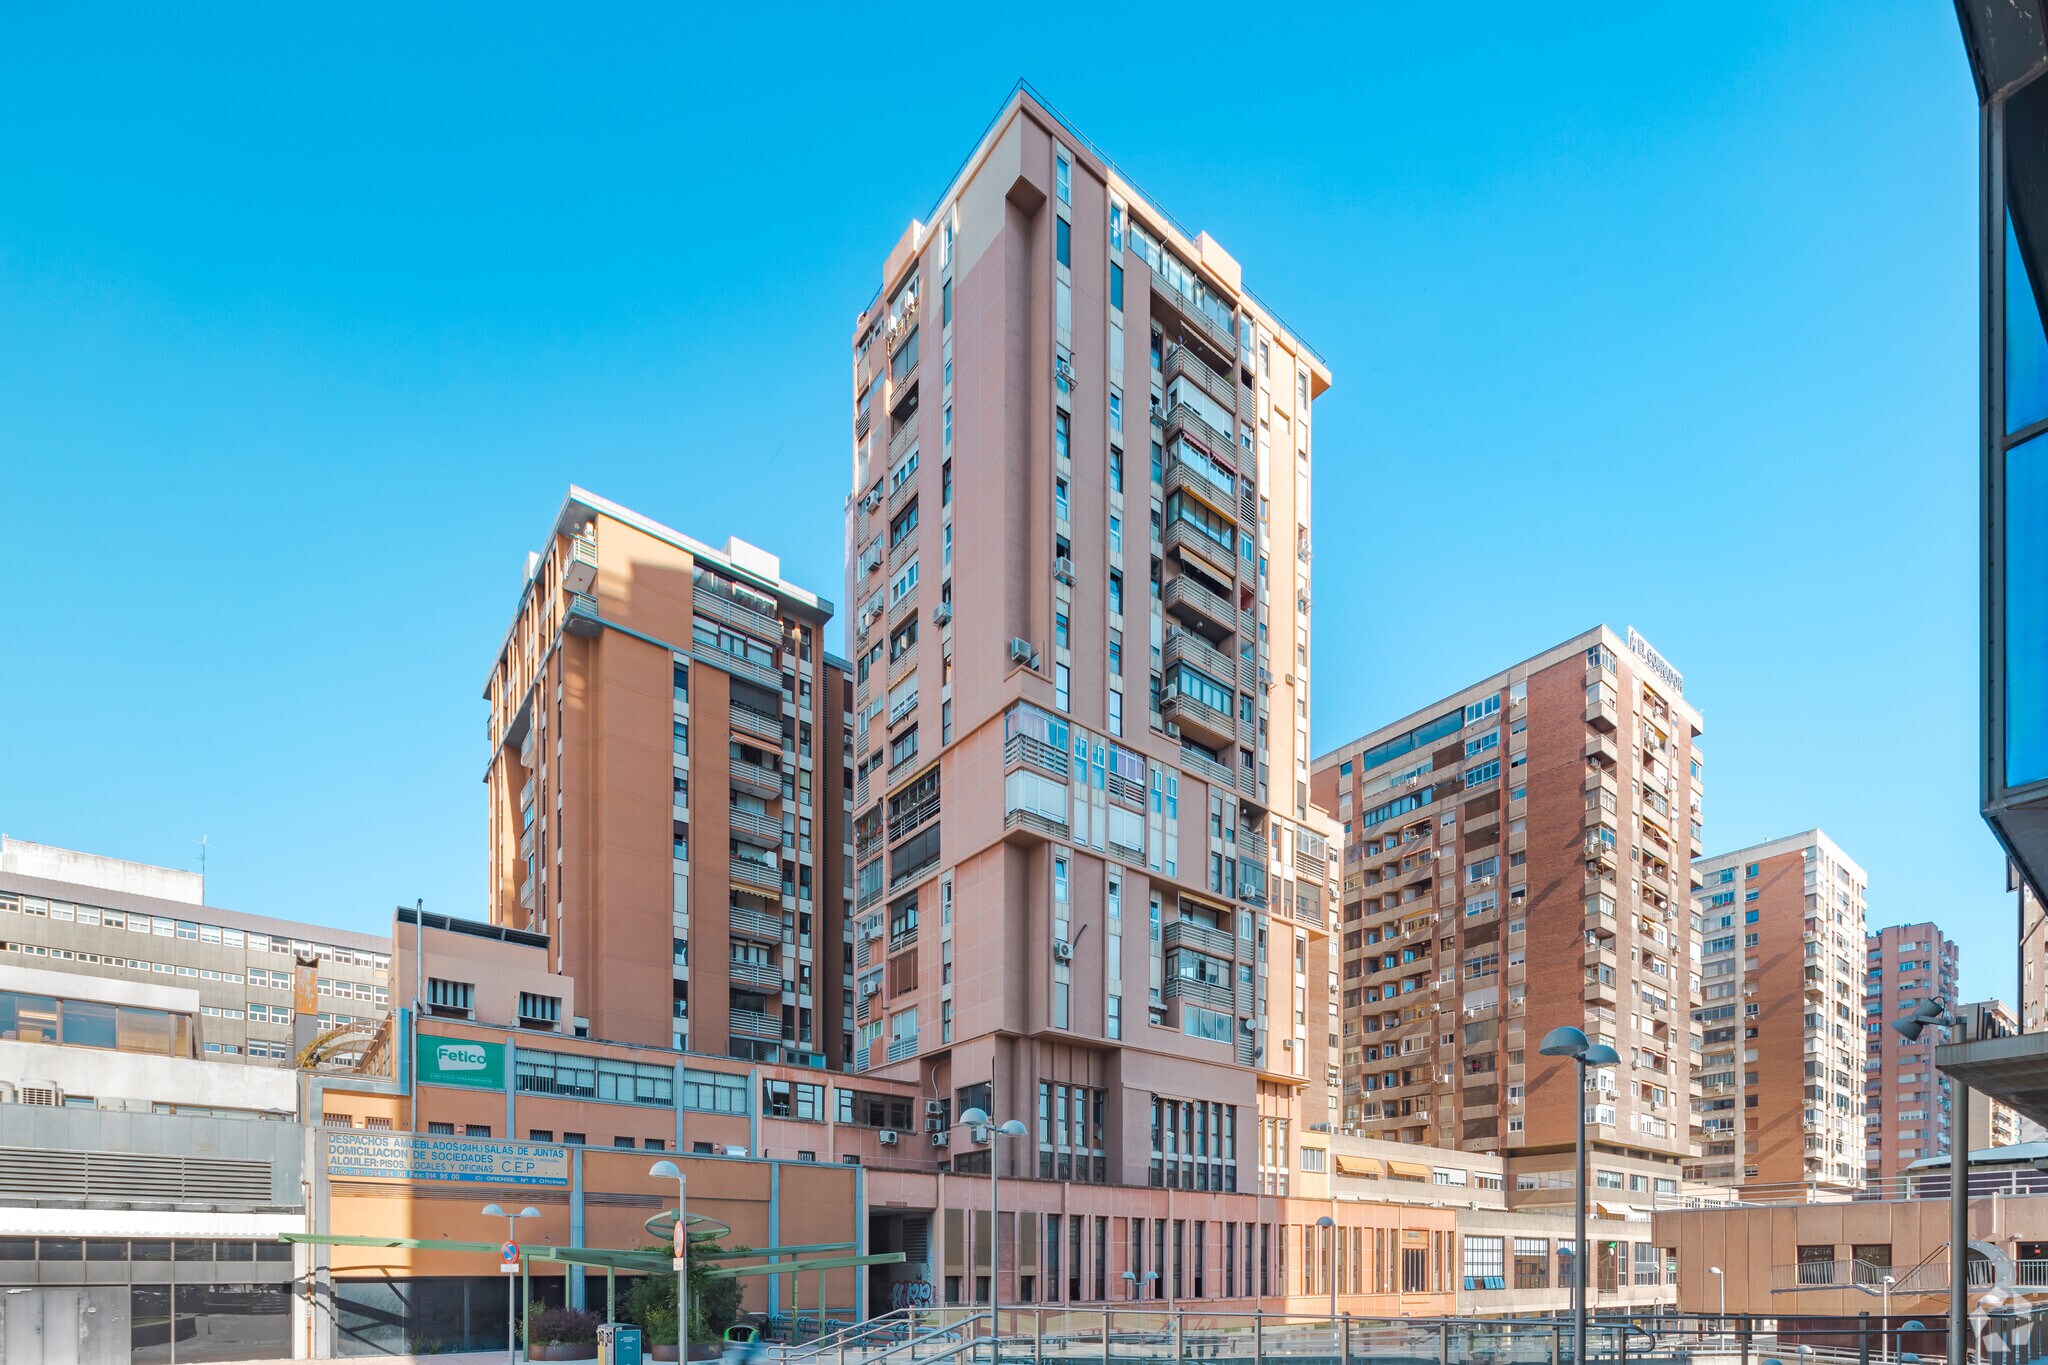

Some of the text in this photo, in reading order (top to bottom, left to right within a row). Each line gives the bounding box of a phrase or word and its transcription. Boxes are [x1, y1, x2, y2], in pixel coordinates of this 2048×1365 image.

[438, 1048, 486, 1065] Fetico
[328, 1133, 389, 1147] DESPACHOS
[394, 1138, 458, 1151] AMUEBLADOS
[484, 1144, 514, 1155] SALAS
[518, 1146, 529, 1156] DE
[533, 1148, 564, 1158] JUNTAS
[328, 1145, 493, 1163] DOMICILIACION DE SOCIEDADES
[330, 1156, 379, 1168] ALQUILER:
[410, 1161, 446, 1171] LOCALES
[450, 1163, 455, 1171] Y
[459, 1164, 493, 1173] OFICINAS
[397, 1170, 406, 1178] 00
